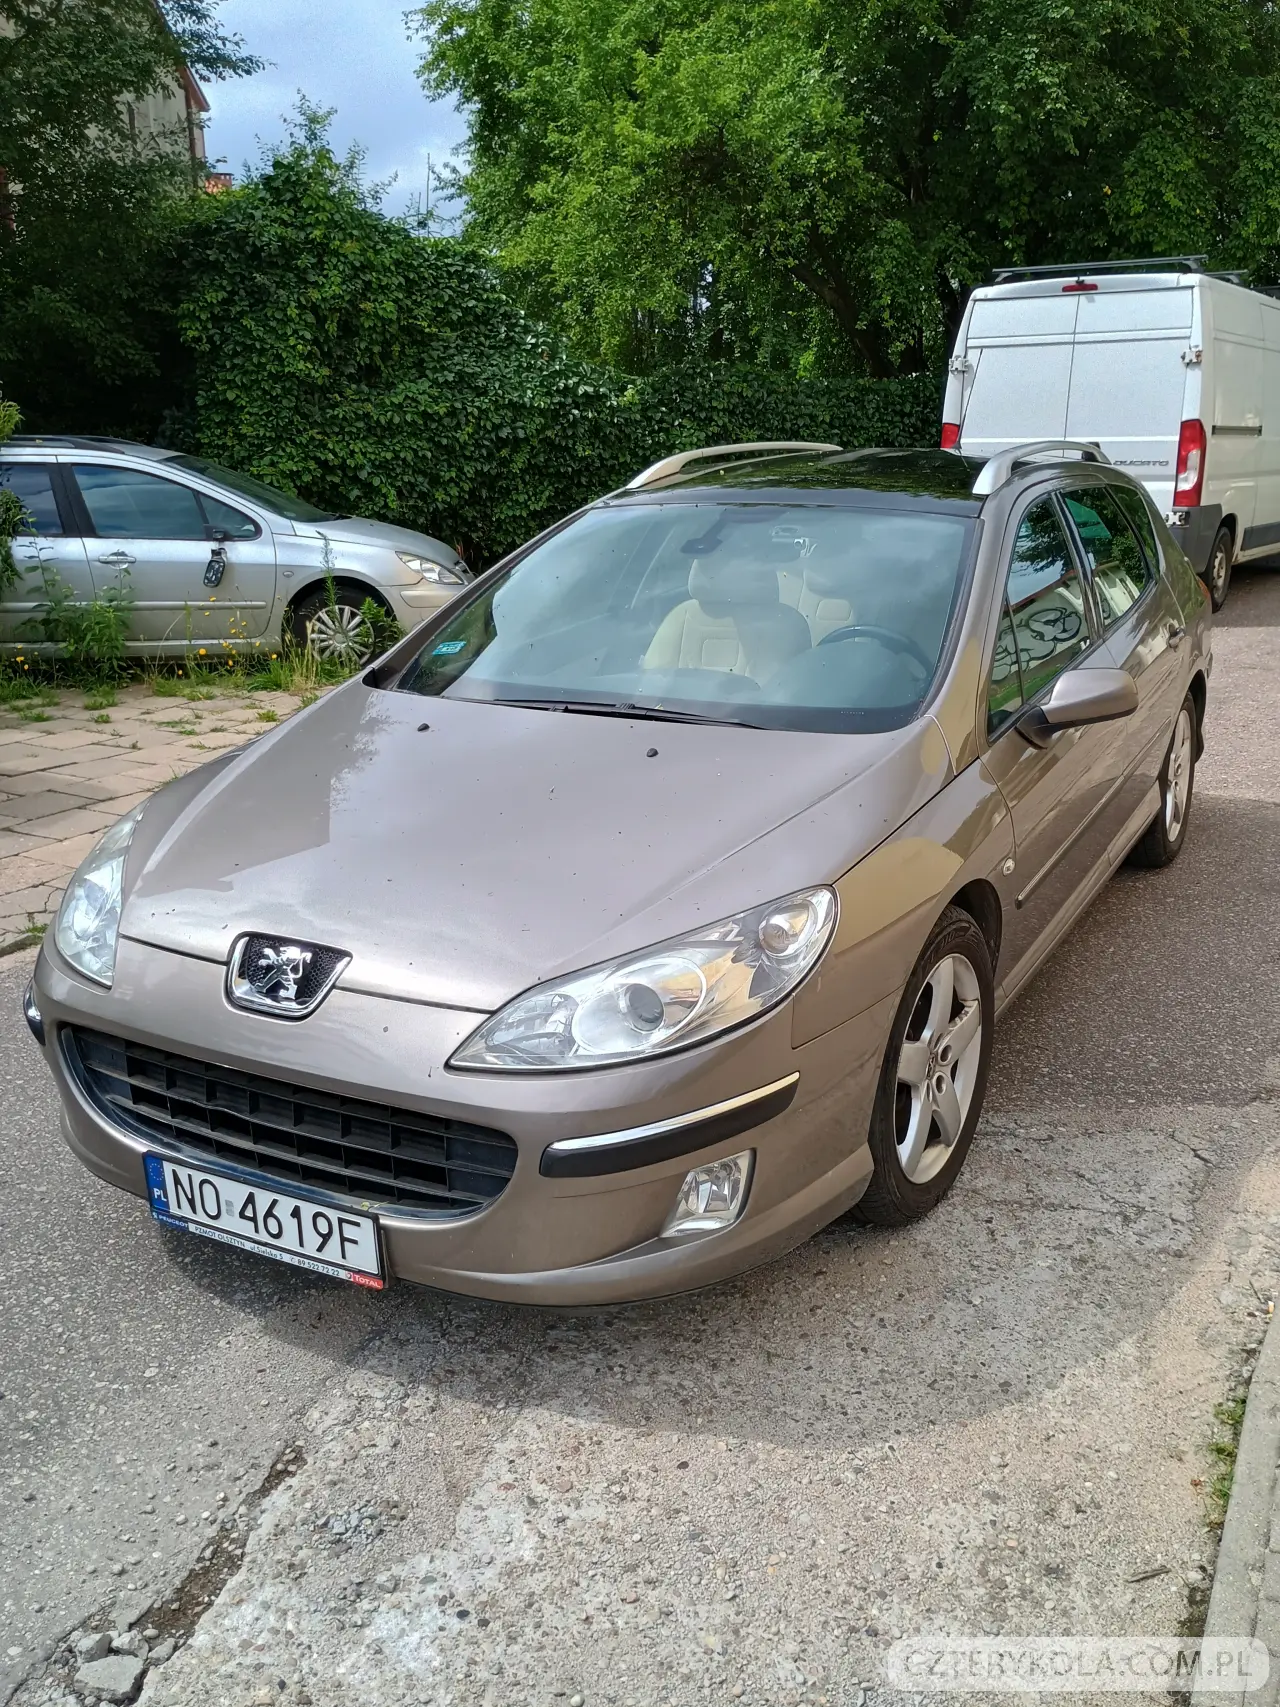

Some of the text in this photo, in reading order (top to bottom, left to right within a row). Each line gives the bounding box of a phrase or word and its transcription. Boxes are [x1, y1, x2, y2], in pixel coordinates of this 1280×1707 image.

[153, 1188, 168, 1202] PL
[158, 1214, 189, 1228] PEUGEOT
[171, 1168, 361, 1260] NO 4619F
[217, 1233, 246, 1248] OLSZTYN
[307, 1261, 320, 1271] 522
[330, 1268, 340, 1277] 22
[354, 1274, 381, 1289] TOTAL
